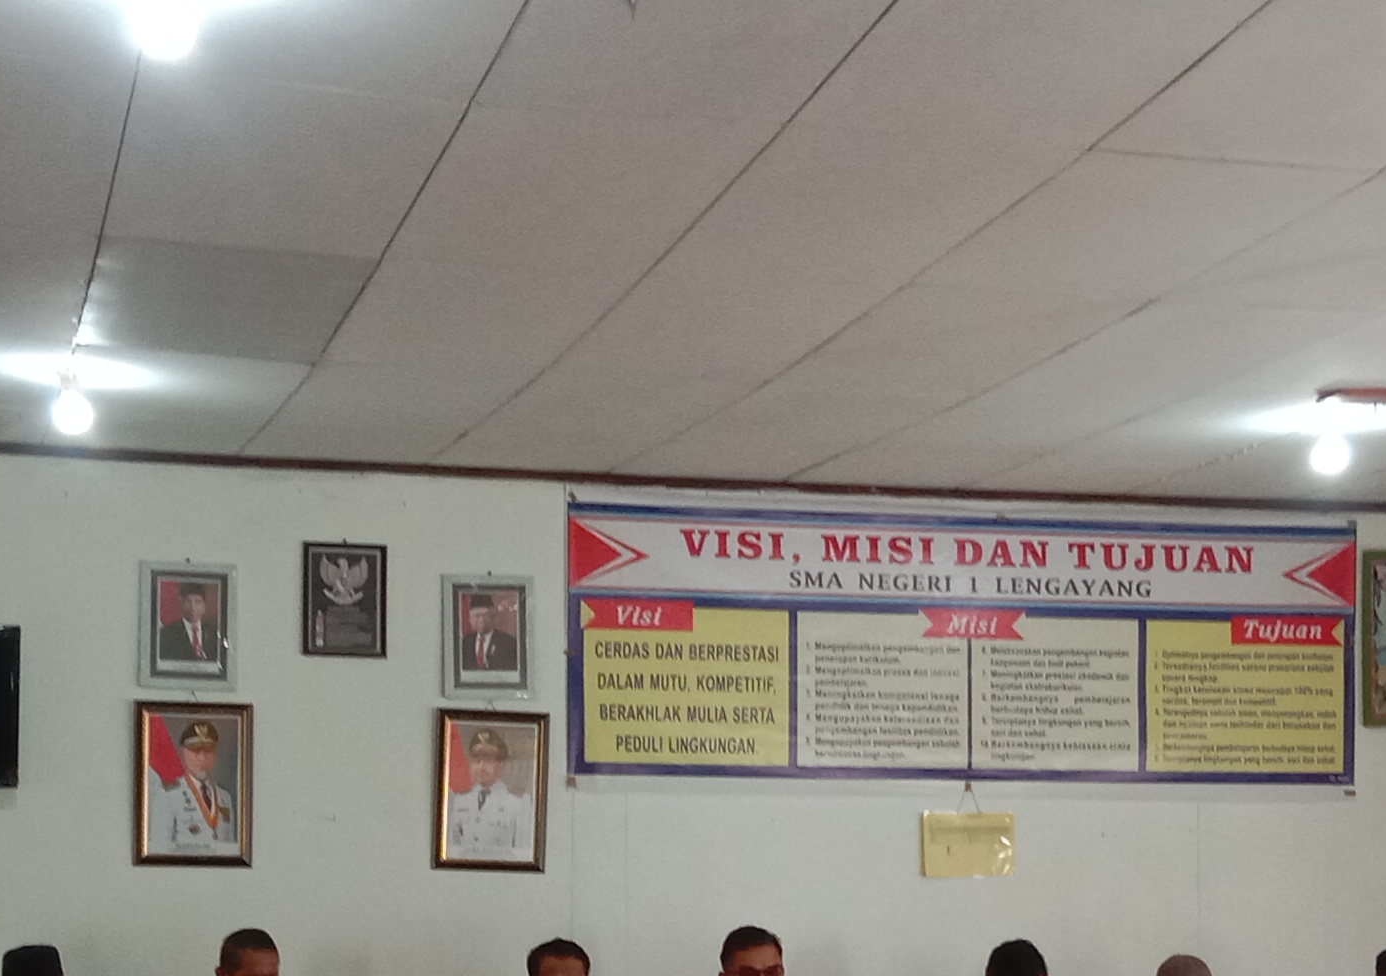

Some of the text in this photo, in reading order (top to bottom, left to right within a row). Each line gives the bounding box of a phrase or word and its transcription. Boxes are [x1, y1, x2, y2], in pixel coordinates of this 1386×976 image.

[680, 529, 1254, 573] VISI, MISI DAN TUJUAN
[789, 570, 1152, 598] SMA NEGERI 1 LENGAYANG
[616, 604, 663, 627] Visi
[946, 613, 998, 635] Misi
[1243, 618, 1323, 643] Tujuan
[595, 641, 779, 663] CERDAS DAN BERPRESTASI
[597, 672, 645, 691] DALAM
[696, 674, 777, 696] KOMPETITIF,
[599, 703, 776, 725] BERAKHLAK MULIA SERTA
[615, 735, 663, 754] PEDULI
